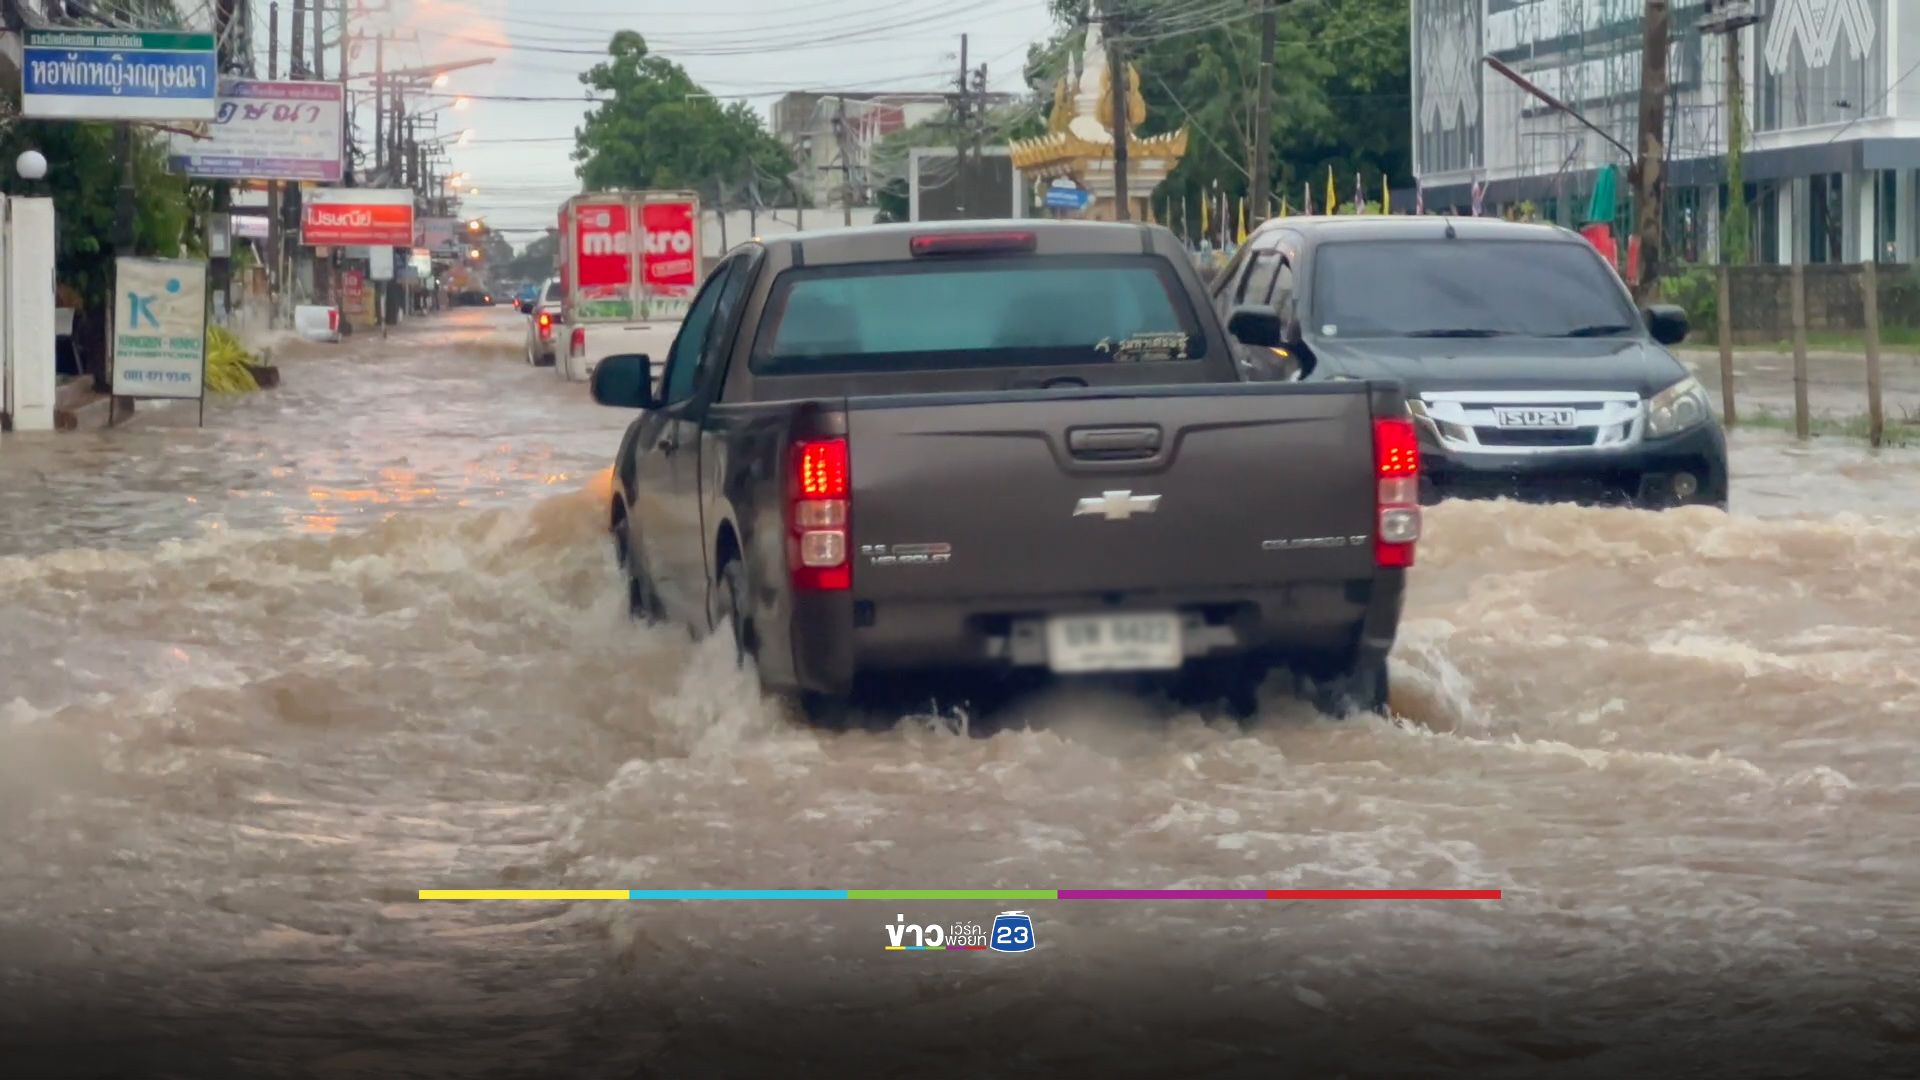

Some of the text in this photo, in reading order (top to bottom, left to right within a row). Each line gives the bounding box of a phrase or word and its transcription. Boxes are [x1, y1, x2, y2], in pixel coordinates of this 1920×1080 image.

[31, 53, 206, 95] หอพักหญิงกฤษณา
[216, 101, 321, 124] ฤษณา
[581, 227, 692, 256] makro
[1499, 411, 1573, 426] ISUZU
